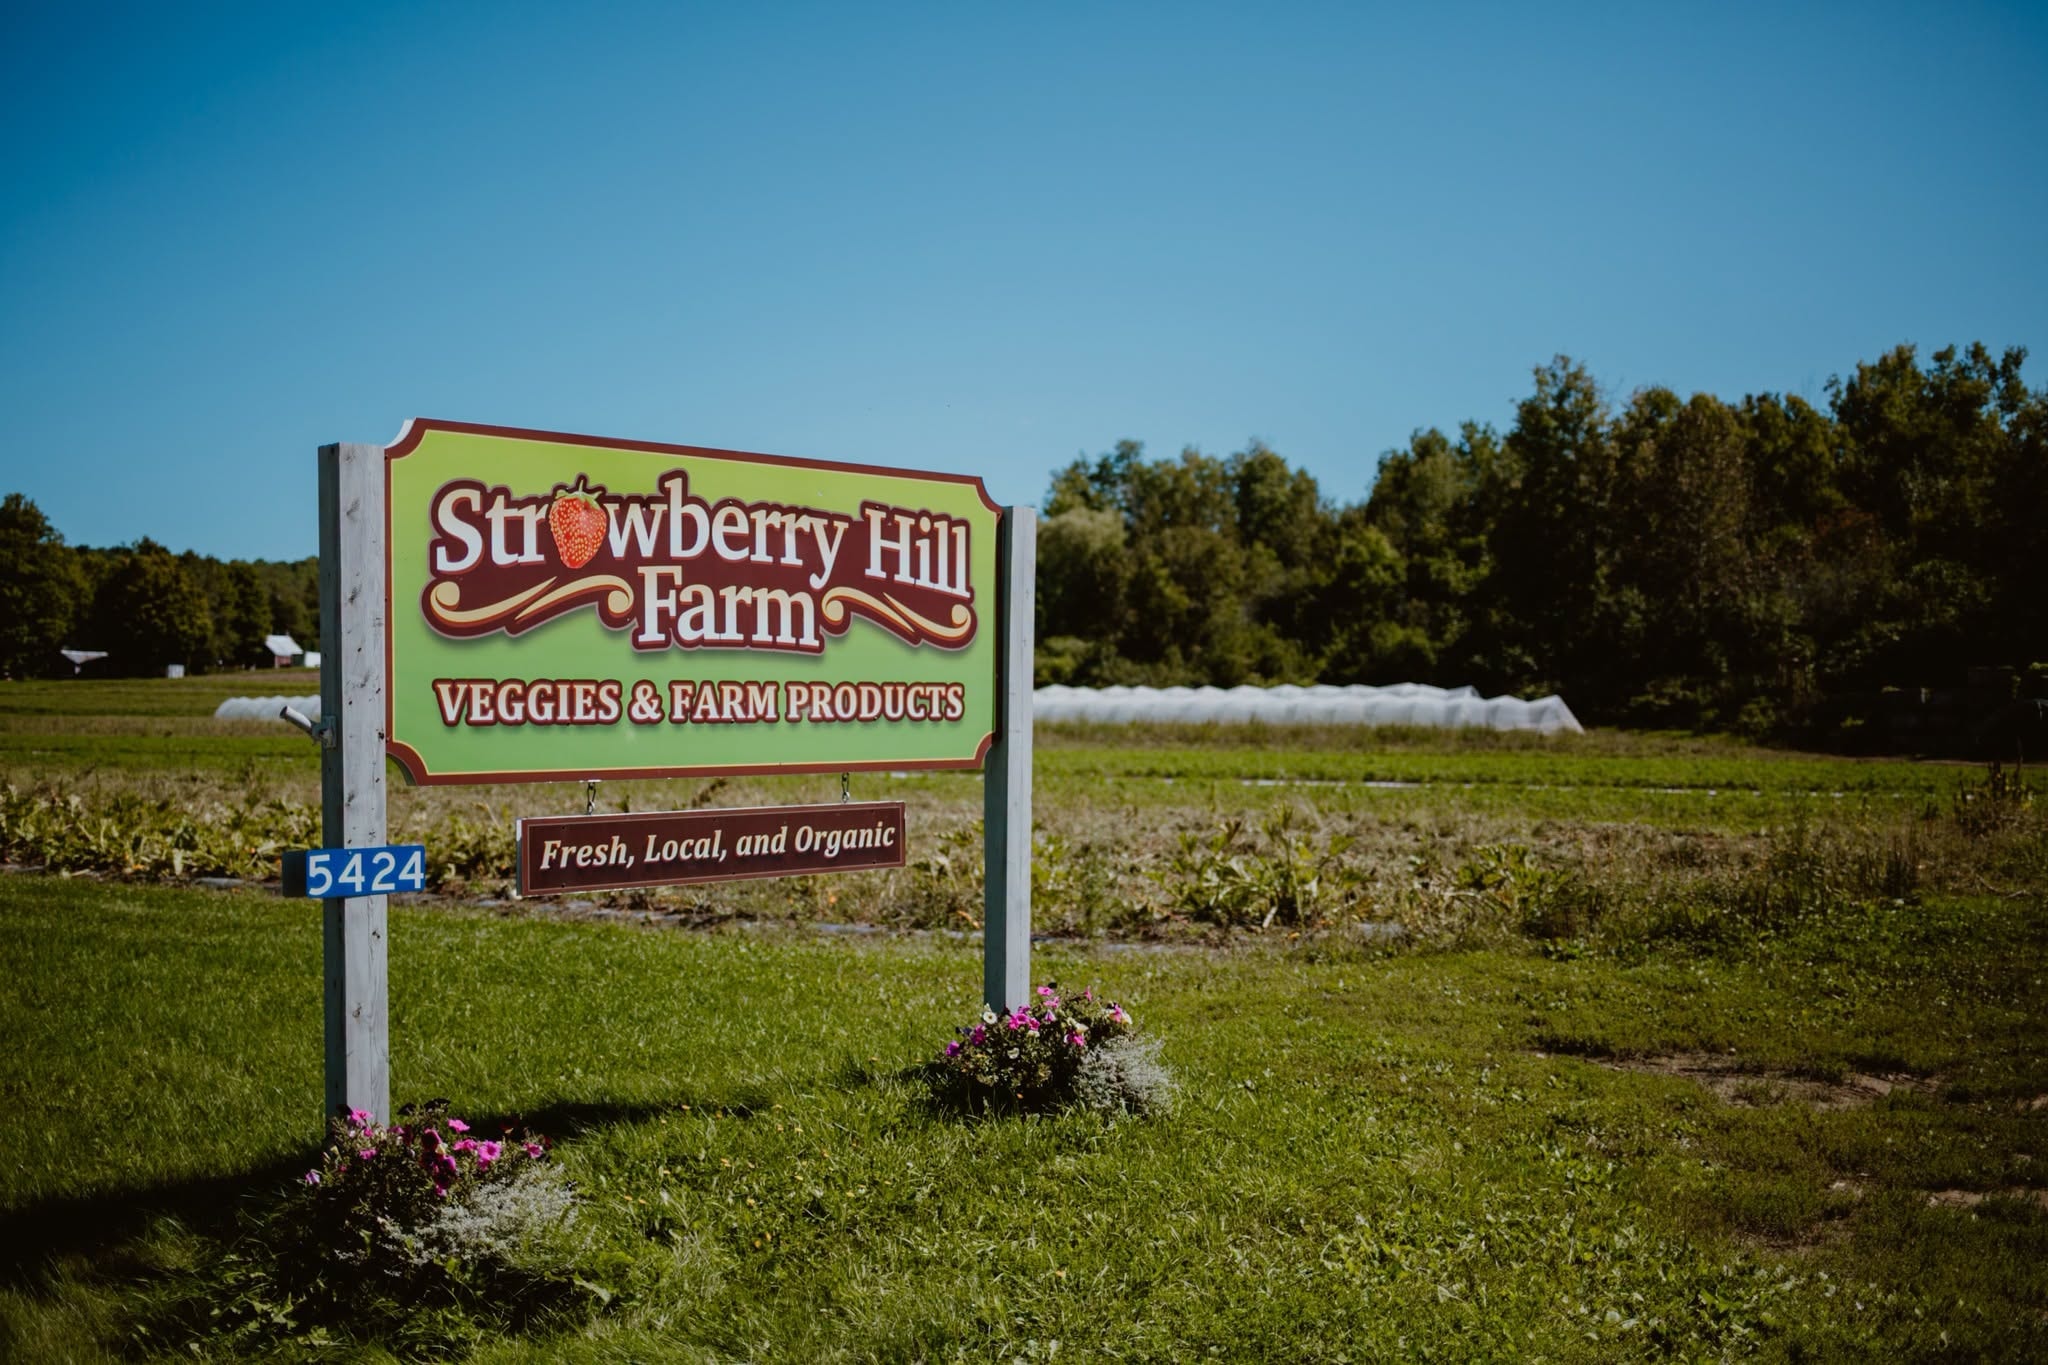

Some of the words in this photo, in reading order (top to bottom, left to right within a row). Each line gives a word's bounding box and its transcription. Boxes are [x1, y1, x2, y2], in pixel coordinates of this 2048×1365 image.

[436, 478, 849, 589] Strwberry
[863, 507, 970, 598] Hill
[636, 564, 820, 649] Farm
[436, 682, 620, 723] VEGGIES
[631, 683, 663, 721] &
[673, 684, 778, 722] FARM
[786, 684, 965, 721] PRODUCTS
[540, 835, 635, 870] Fresh,
[644, 833, 728, 864] Local,
[735, 825, 786, 857] and
[794, 822, 896, 859] Organic
[307, 851, 426, 898] 5424
